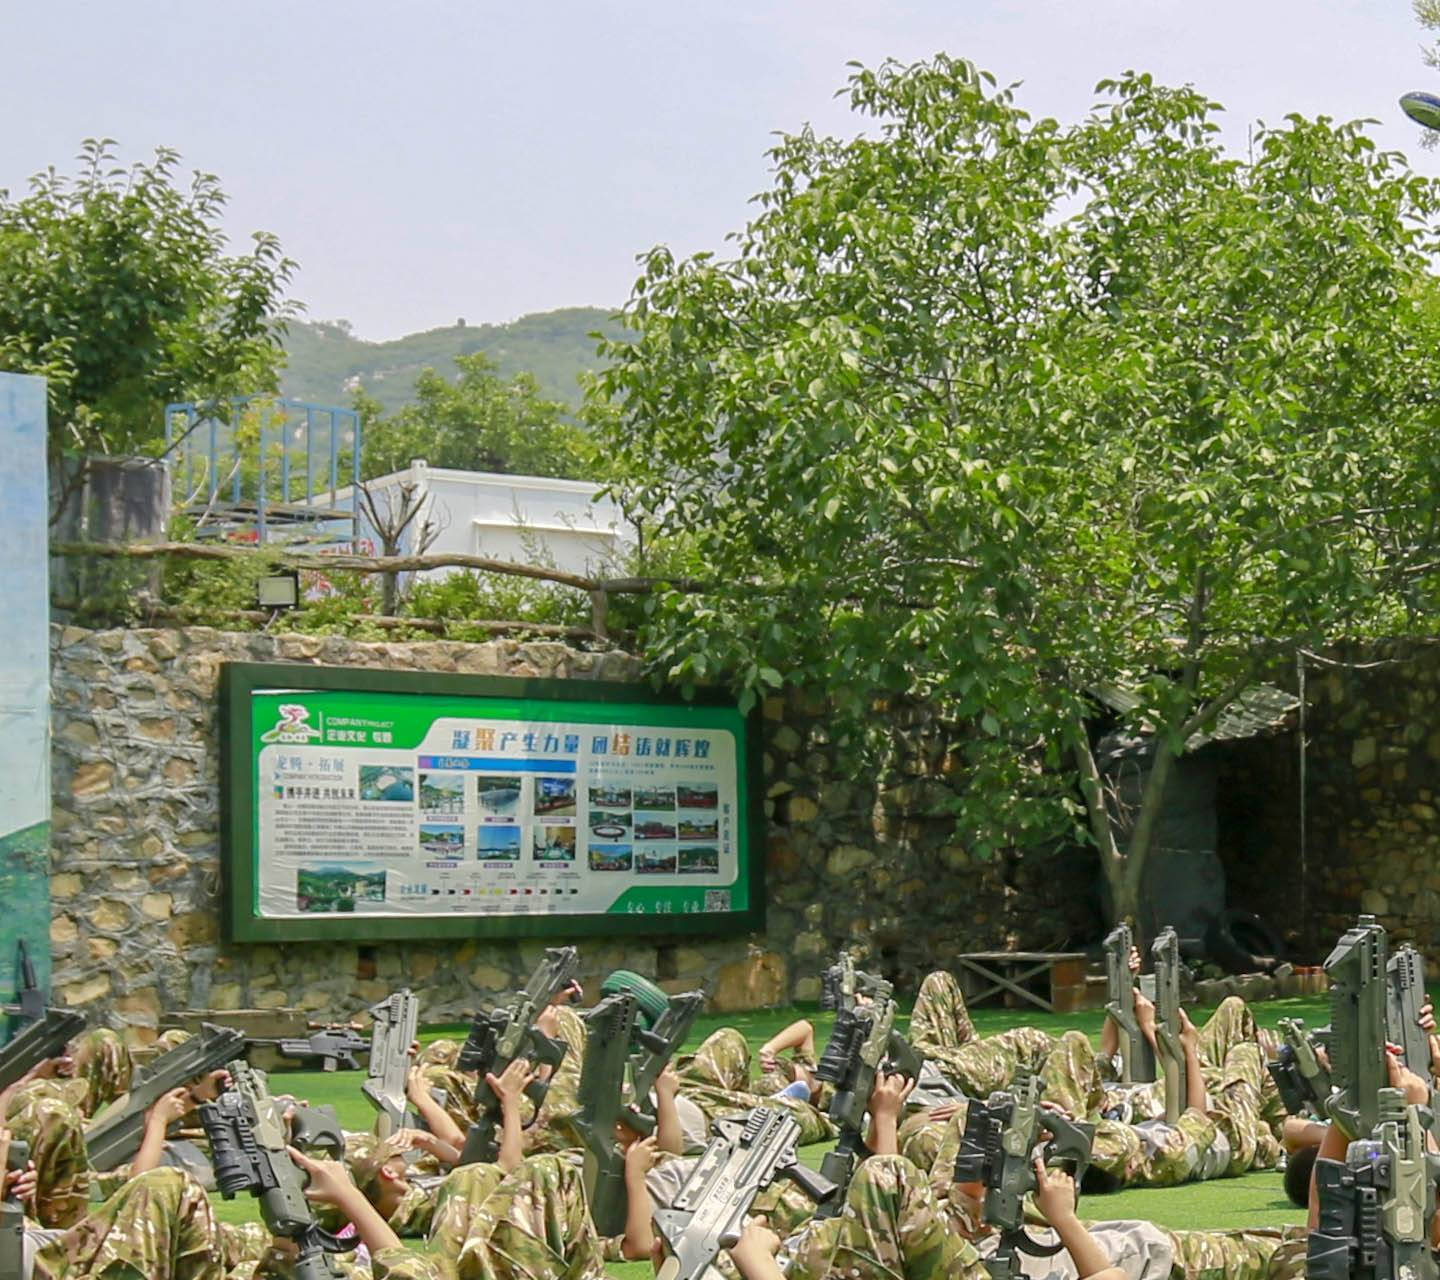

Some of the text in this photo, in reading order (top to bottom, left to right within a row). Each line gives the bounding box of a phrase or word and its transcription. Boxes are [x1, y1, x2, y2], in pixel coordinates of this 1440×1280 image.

[452, 727, 711, 760] 凝聚产生力量 团结铸就辉煌
